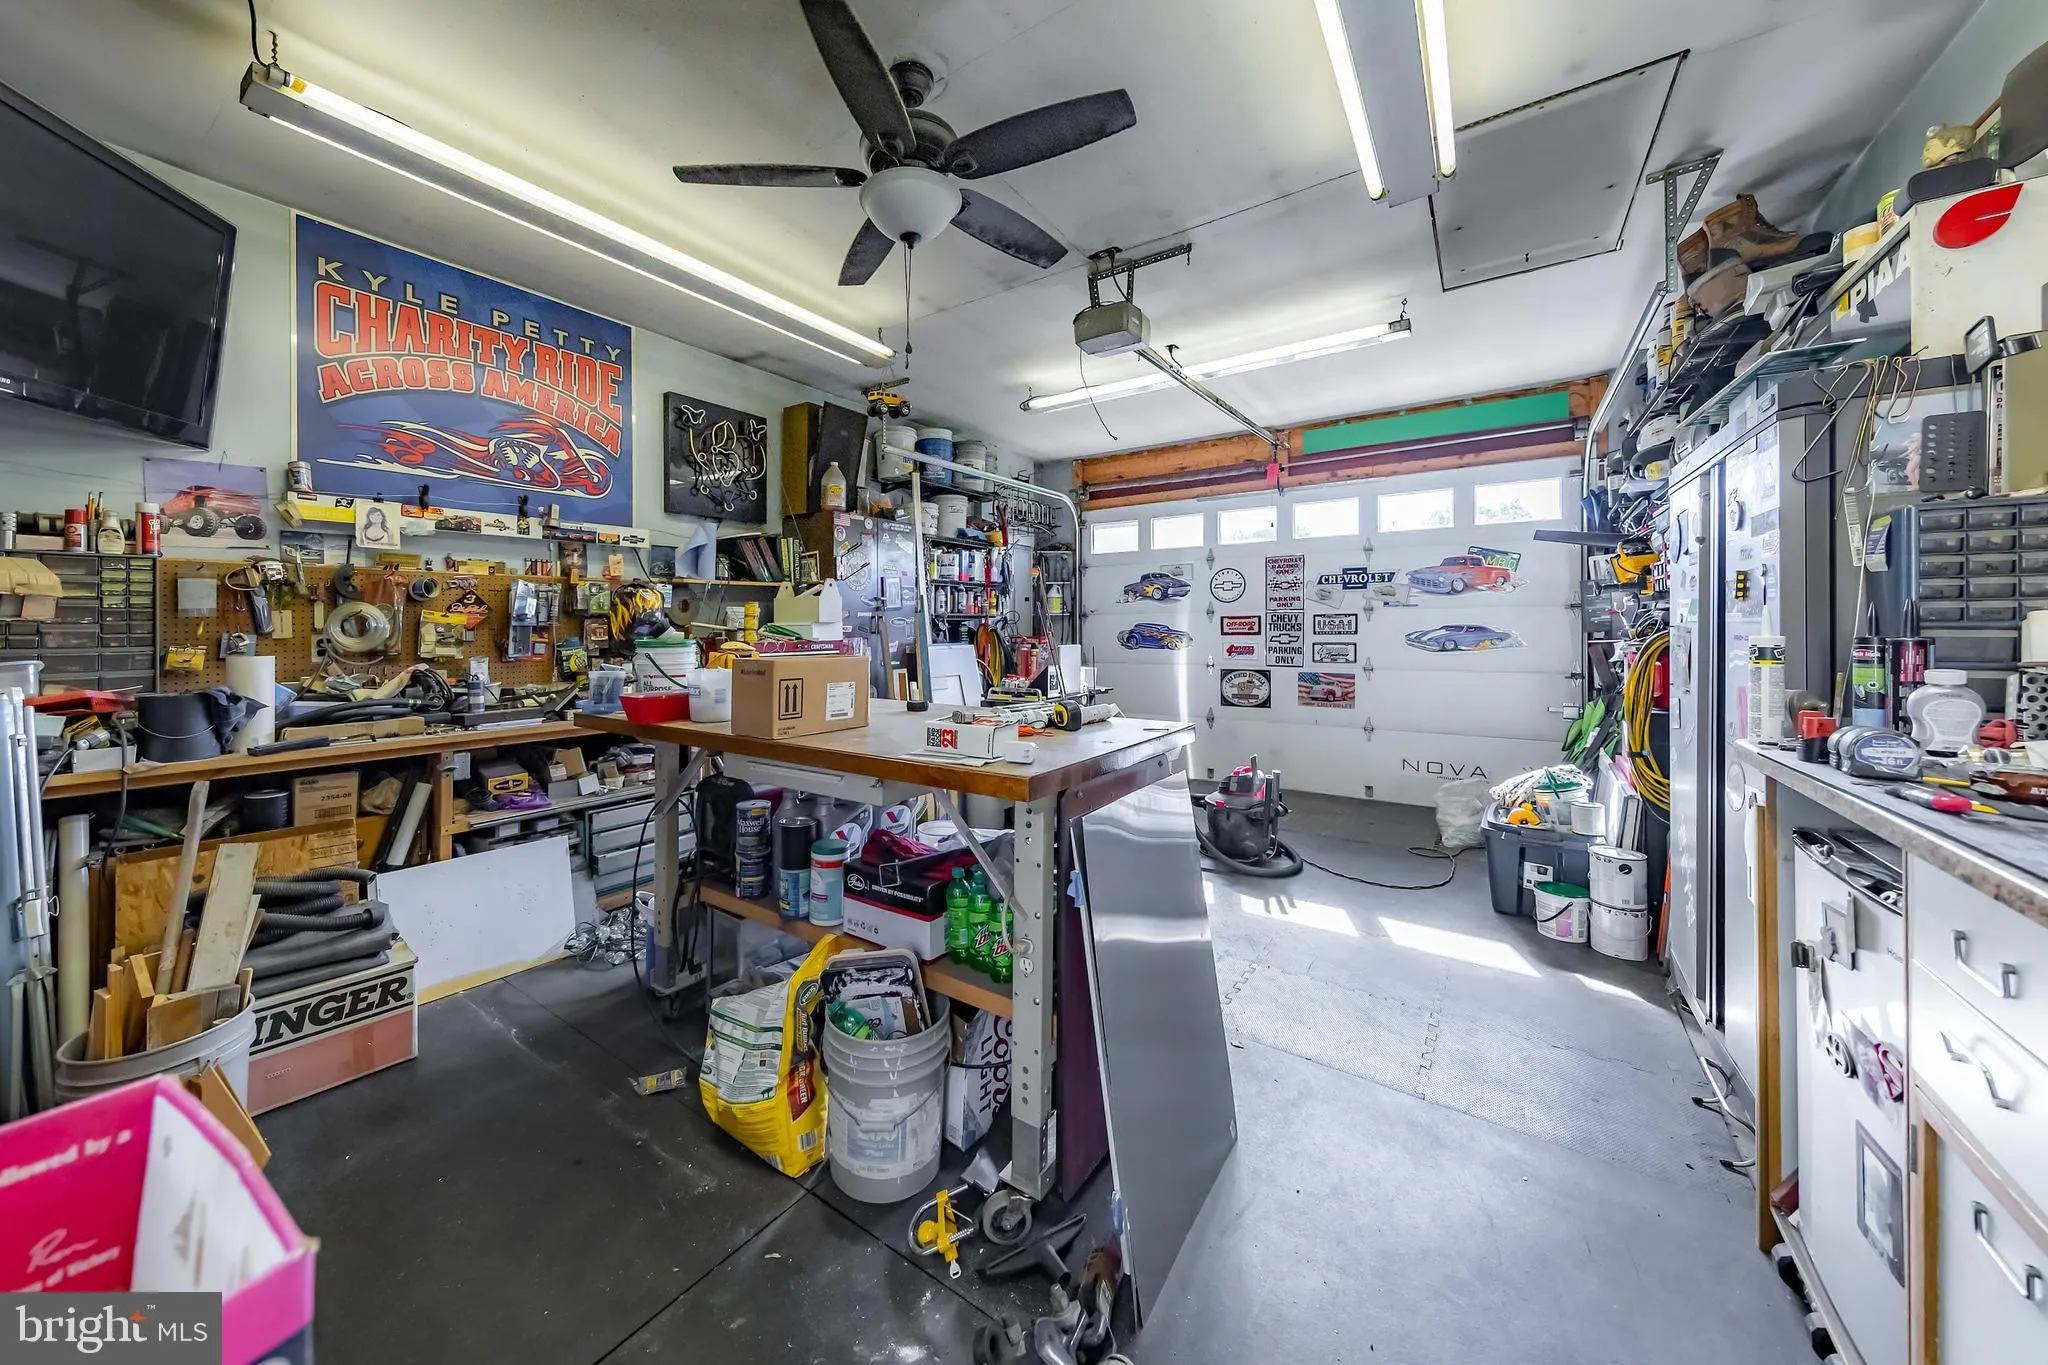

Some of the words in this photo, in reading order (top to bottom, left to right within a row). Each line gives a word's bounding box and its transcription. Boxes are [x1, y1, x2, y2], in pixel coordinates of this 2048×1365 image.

[1850, 238, 1910, 317] PIAA
[317, 257, 458, 314] KYLE
[492, 310, 622, 361] PETTY
[314, 280, 531, 374] CHARITY
[534, 341, 623, 427] RIDE
[316, 356, 476, 403] ACROSS
[481, 367, 623, 458] AMERICA
[1321, 572, 1391, 584] CHEVROLET
[1268, 622, 1302, 632] TRUCKS
[1270, 613, 1299, 623] CHEVY
[1268, 646, 1302, 655] PARKING
[1275, 655, 1295, 664] ONLY
[942, 729, 954, 748] 23
[1402, 759, 1487, 779] NOVA
[738, 818, 765, 827] Maxwell
[740, 824, 762, 833] House
[249, 976, 409, 1049] INGER
[979, 1035, 993, 1114] LIGHT
